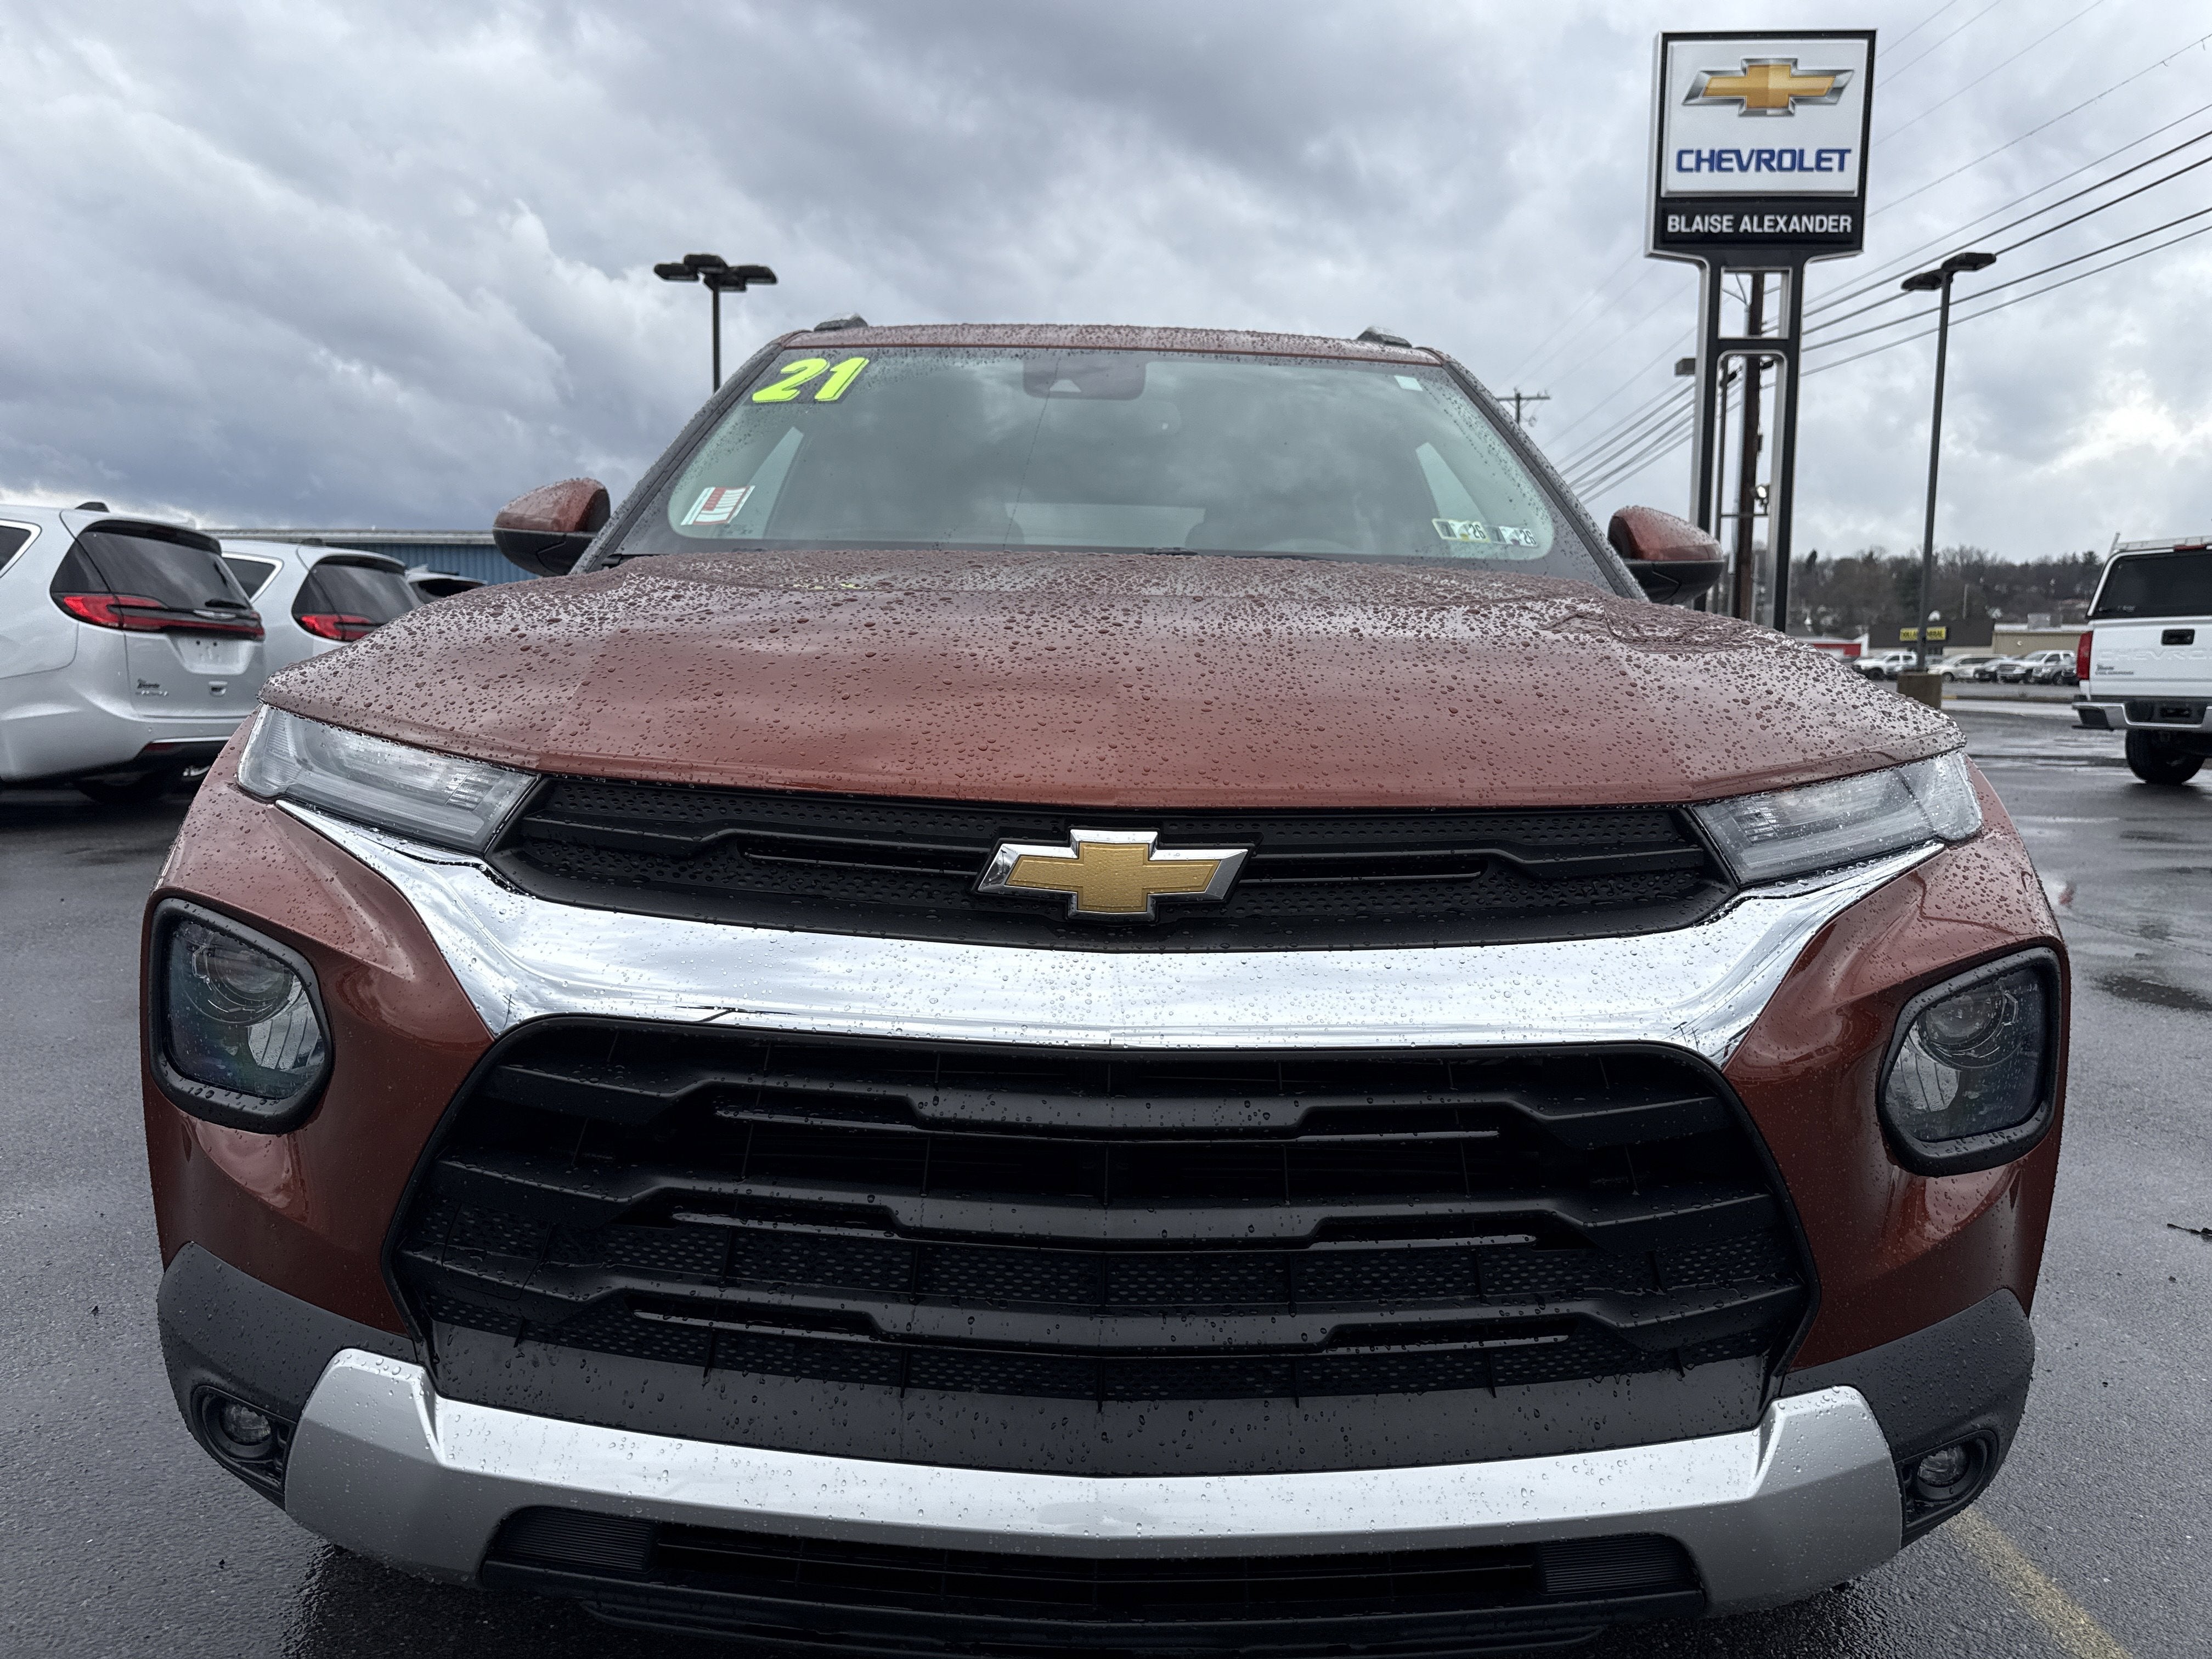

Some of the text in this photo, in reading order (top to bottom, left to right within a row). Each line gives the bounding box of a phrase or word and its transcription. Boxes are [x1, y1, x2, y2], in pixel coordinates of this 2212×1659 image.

[1676, 149, 1852, 172] CHEVROLET
[1667, 215, 1852, 233] BLAISE ALEXANDER
[752, 358, 870, 403] 21
[1469, 524, 1486, 539] 26
[1519, 530, 1537, 545] 26
[2098, 648, 2212, 661] CHEVRO
